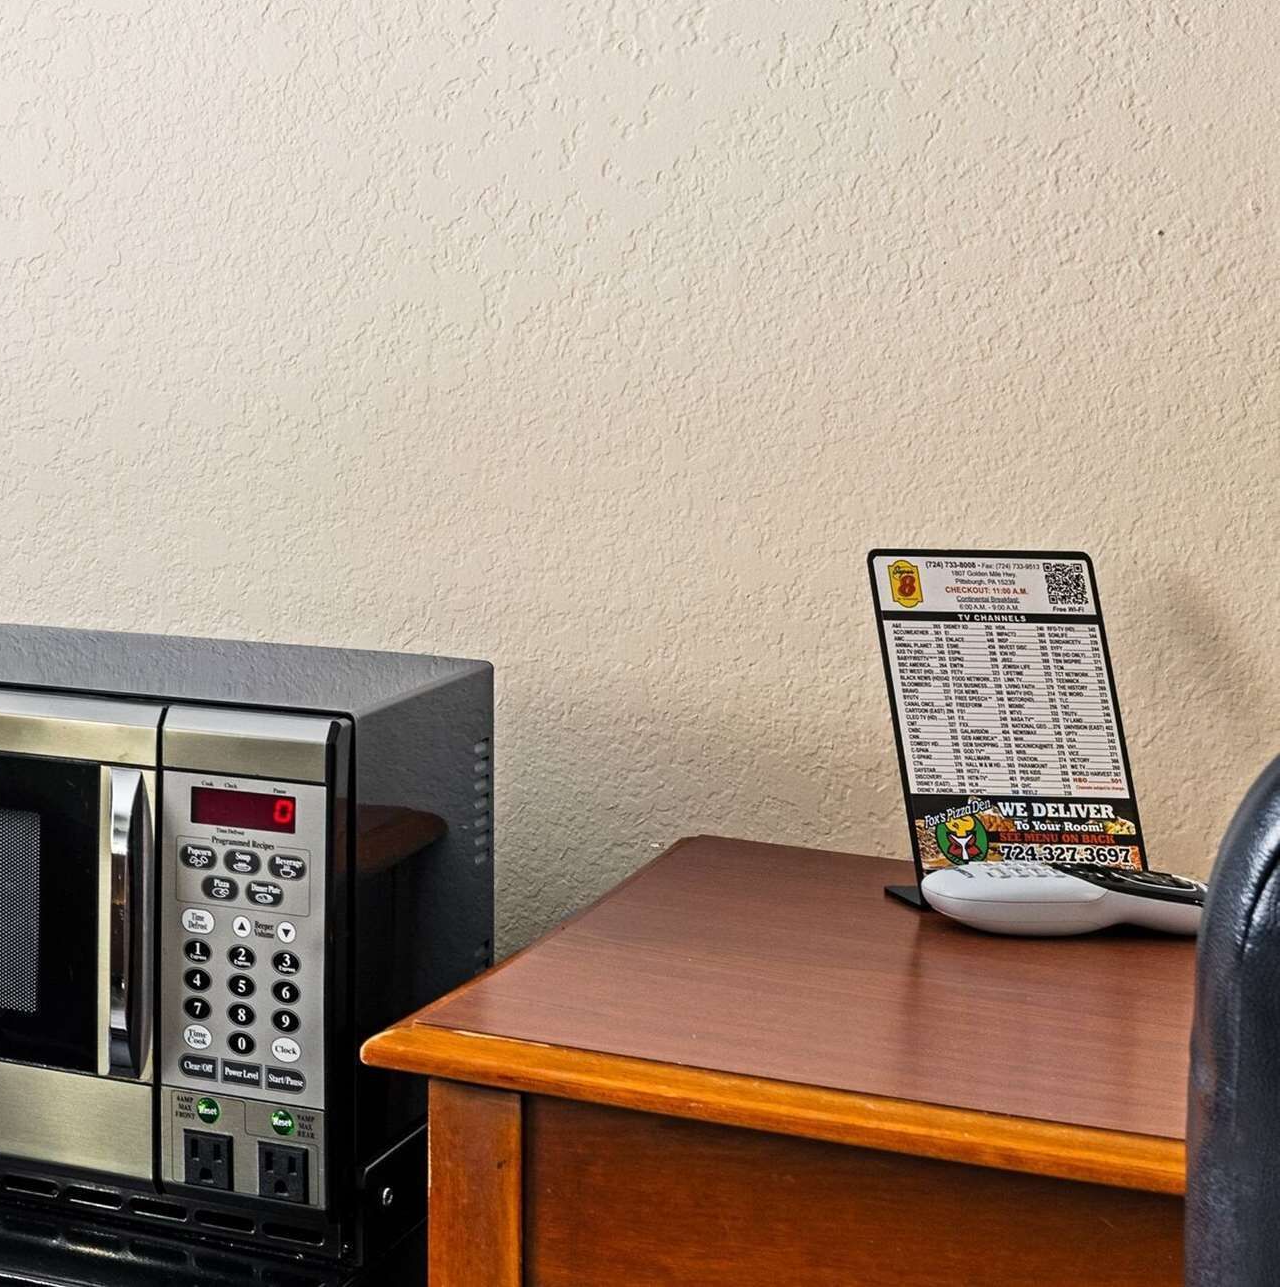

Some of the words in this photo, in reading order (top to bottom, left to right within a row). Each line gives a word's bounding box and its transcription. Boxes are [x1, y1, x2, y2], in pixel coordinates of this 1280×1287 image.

[925, 561, 944, 569] (724)
[898, 575, 916, 597] 8
[945, 586, 991, 594] CHECKOUT:
[973, 614, 1027, 622] CHANNELS
[273, 799, 294, 823] 0
[924, 812, 946, 829] Fox's
[946, 805, 972, 822] Pizza
[972, 799, 991, 814] Den
[997, 802, 1027, 817] WE
[1031, 802, 1116, 819] DELIVER
[1014, 820, 1030, 831] To
[1032, 821, 1061, 831] Your
[1064, 821, 1104, 832] Room!
[211, 835, 250, 848] Programmed
[252, 840, 275, 850] Recipes
[999, 832, 1021, 842] SEE
[1024, 833, 1059, 843] MENU
[1062, 834, 1080, 843] ON
[1082, 834, 1116, 844] BACK
[187, 846, 212, 857] Popcorn
[235, 852, 252, 862] Soup
[1001, 845, 1131, 864] 724.327.3697
[275, 856, 303, 868] Beverage
[213, 879, 230, 888] Pizza
[251, 883, 267, 892] Dinner
[268, 885, 281, 894] Plate
[192, 913, 205, 921] Time
[188, 920, 207, 930] Defrost
[254, 920, 274, 930] Beeper
[195, 942, 201, 955] 1
[237, 948, 246, 960] 2
[282, 954, 291, 967] 3
[193, 973, 201, 987] 4
[237, 980, 246, 993] 5
[281, 986, 290, 999] 6
[193, 1002, 201, 1015] 7
[237, 1008, 246, 1021] 8
[281, 1014, 290, 1028] 9
[188, 1029, 208, 1038] Time
[187, 1036, 207, 1045] Cook
[237, 1037, 246, 1050] 0
[275, 1045, 297, 1055] Clock
[184, 1061, 213, 1073] Clear/Off
[224, 1066, 243, 1077] Power
[243, 1069, 259, 1080] Level
[268, 1073, 304, 1087] Start/Pause
[178, 1103, 192, 1111] MAX
[175, 1111, 195, 1120] FRONT
[299, 1123, 313, 1131] MAX
